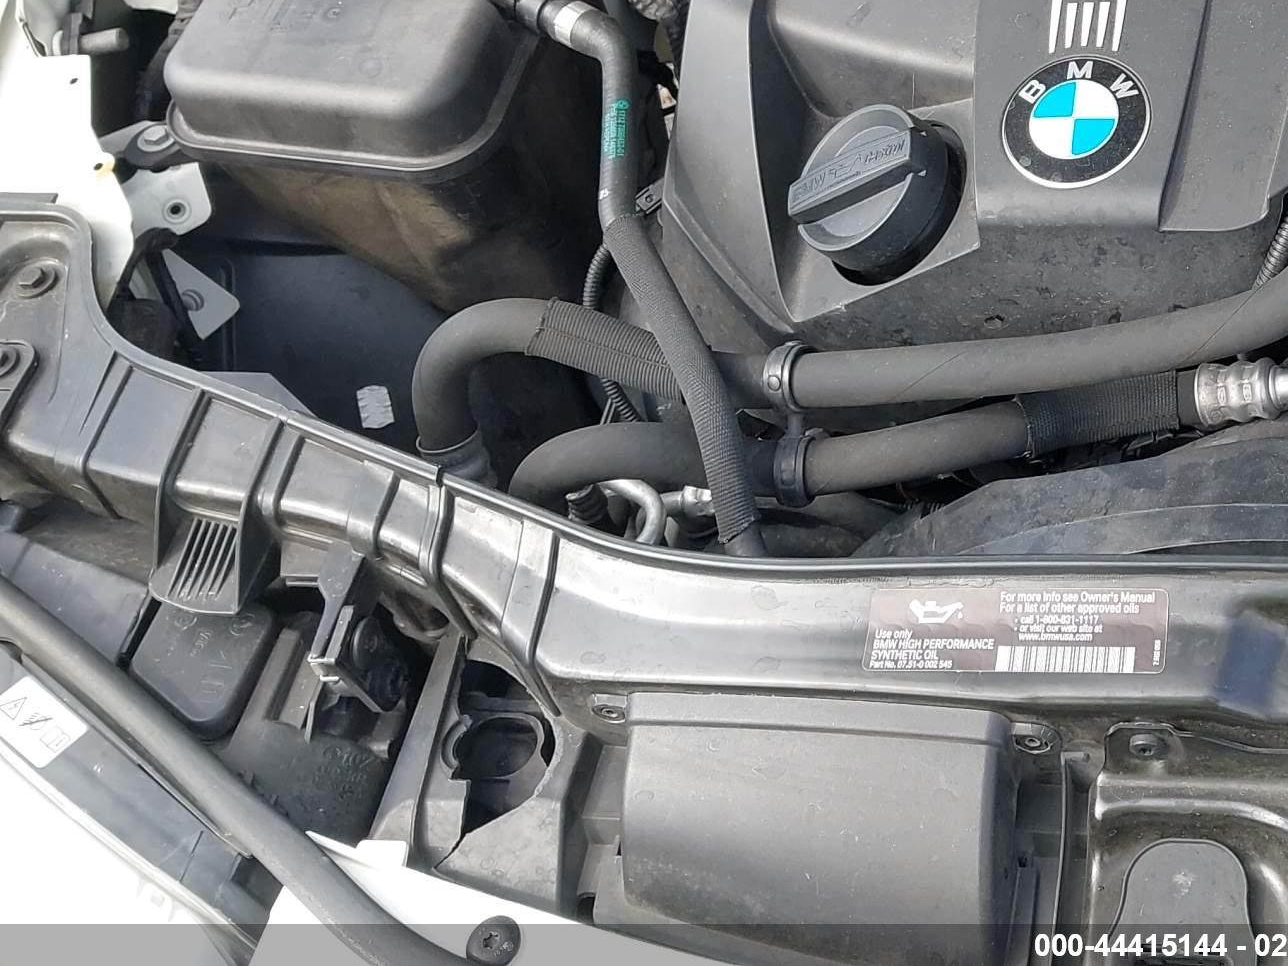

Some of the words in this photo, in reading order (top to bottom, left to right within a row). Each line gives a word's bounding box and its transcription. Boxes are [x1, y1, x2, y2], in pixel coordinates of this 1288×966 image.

[1019, 61, 1139, 105] BMW
[1000, 591, 1017, 602] For
[1018, 593, 1041, 602] more
[1081, 591, 1119, 603] Owner's
[1121, 591, 1155, 603] Manual
[1000, 603, 1016, 613] For
[1039, 603, 1050, 613] of
[1051, 603, 1076, 613] other
[1077, 603, 1121, 614] approved
[875, 629, 891, 639] Use
[893, 629, 913, 641] only
[873, 639, 898, 650] BMW
[897, 638, 921, 650] HIGH
[922, 639, 994, 650] PERFORMANCE
[870, 650, 922, 661] SYNTHETIC
[923, 650, 939, 660] OIL
